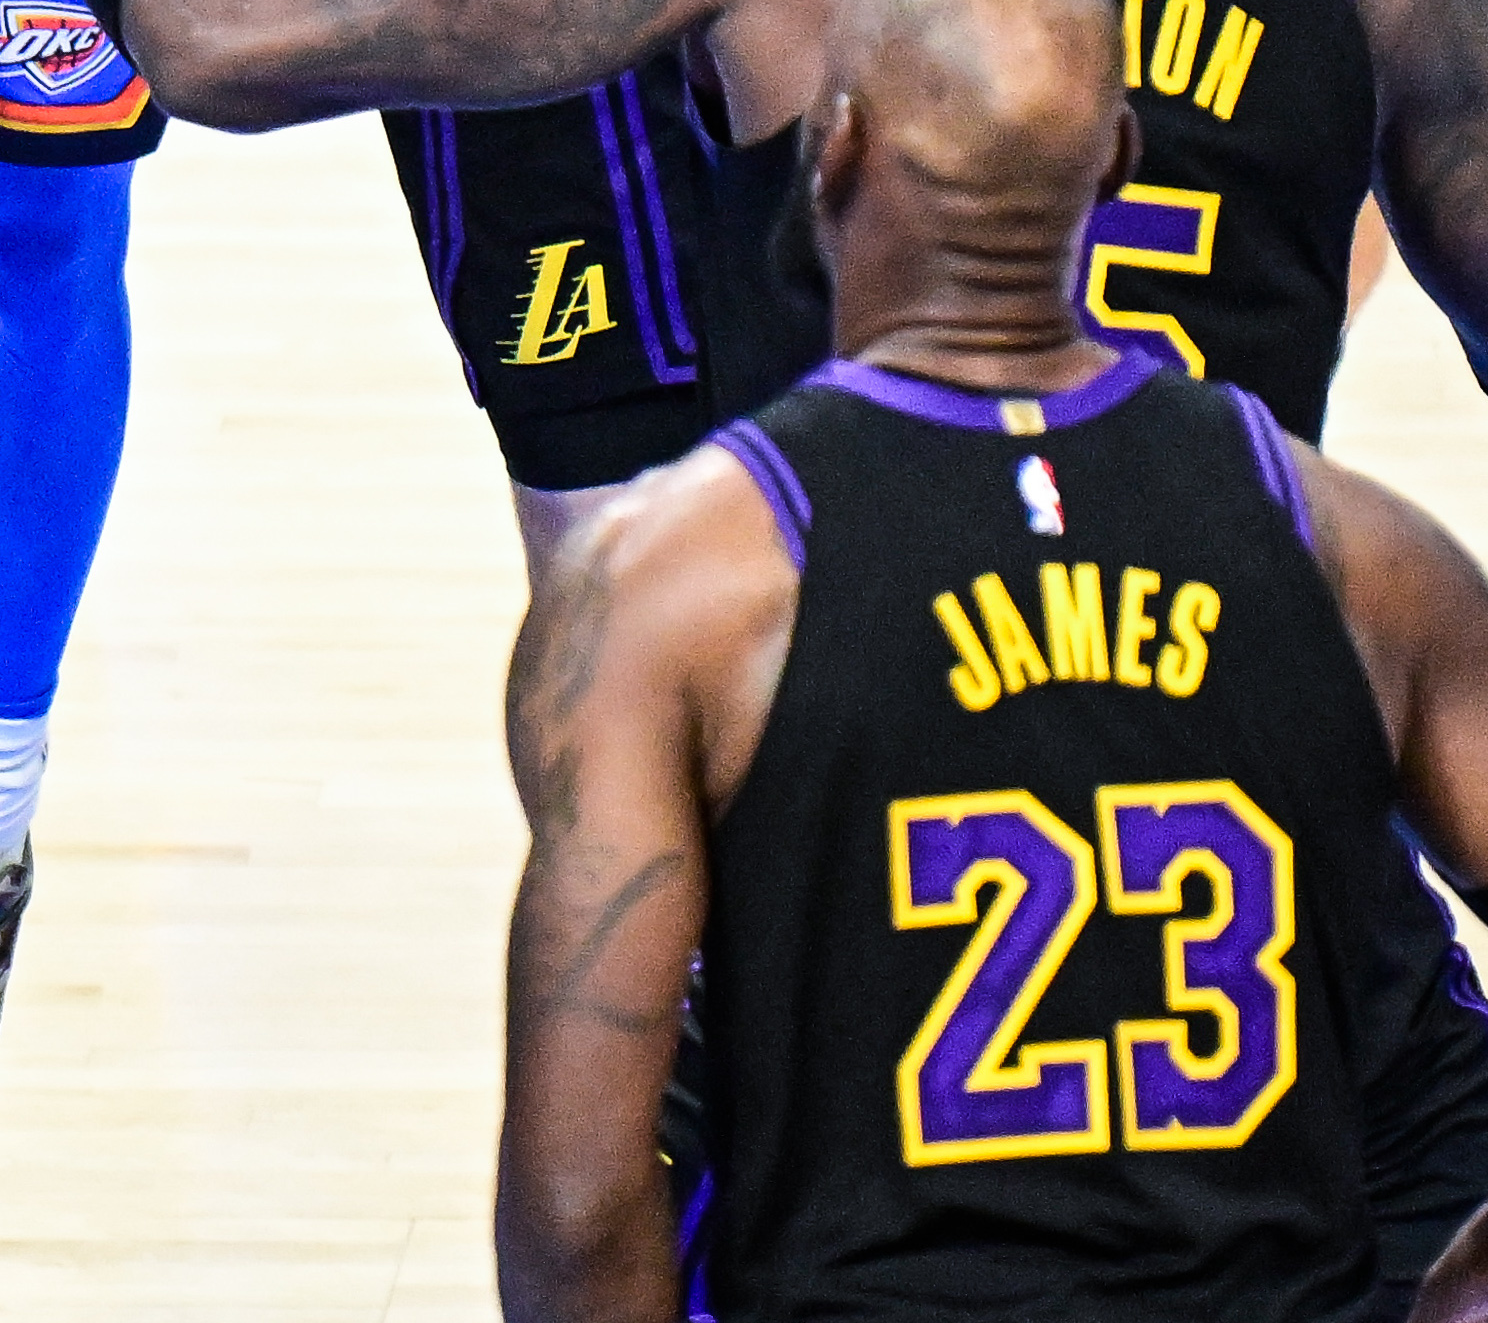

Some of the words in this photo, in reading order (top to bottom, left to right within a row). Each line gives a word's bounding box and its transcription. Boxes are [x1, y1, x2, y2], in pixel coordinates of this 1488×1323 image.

[495, 238, 618, 365] LA
[932, 561, 1221, 713] JAMES
[887, 778, 1298, 1168] 23
